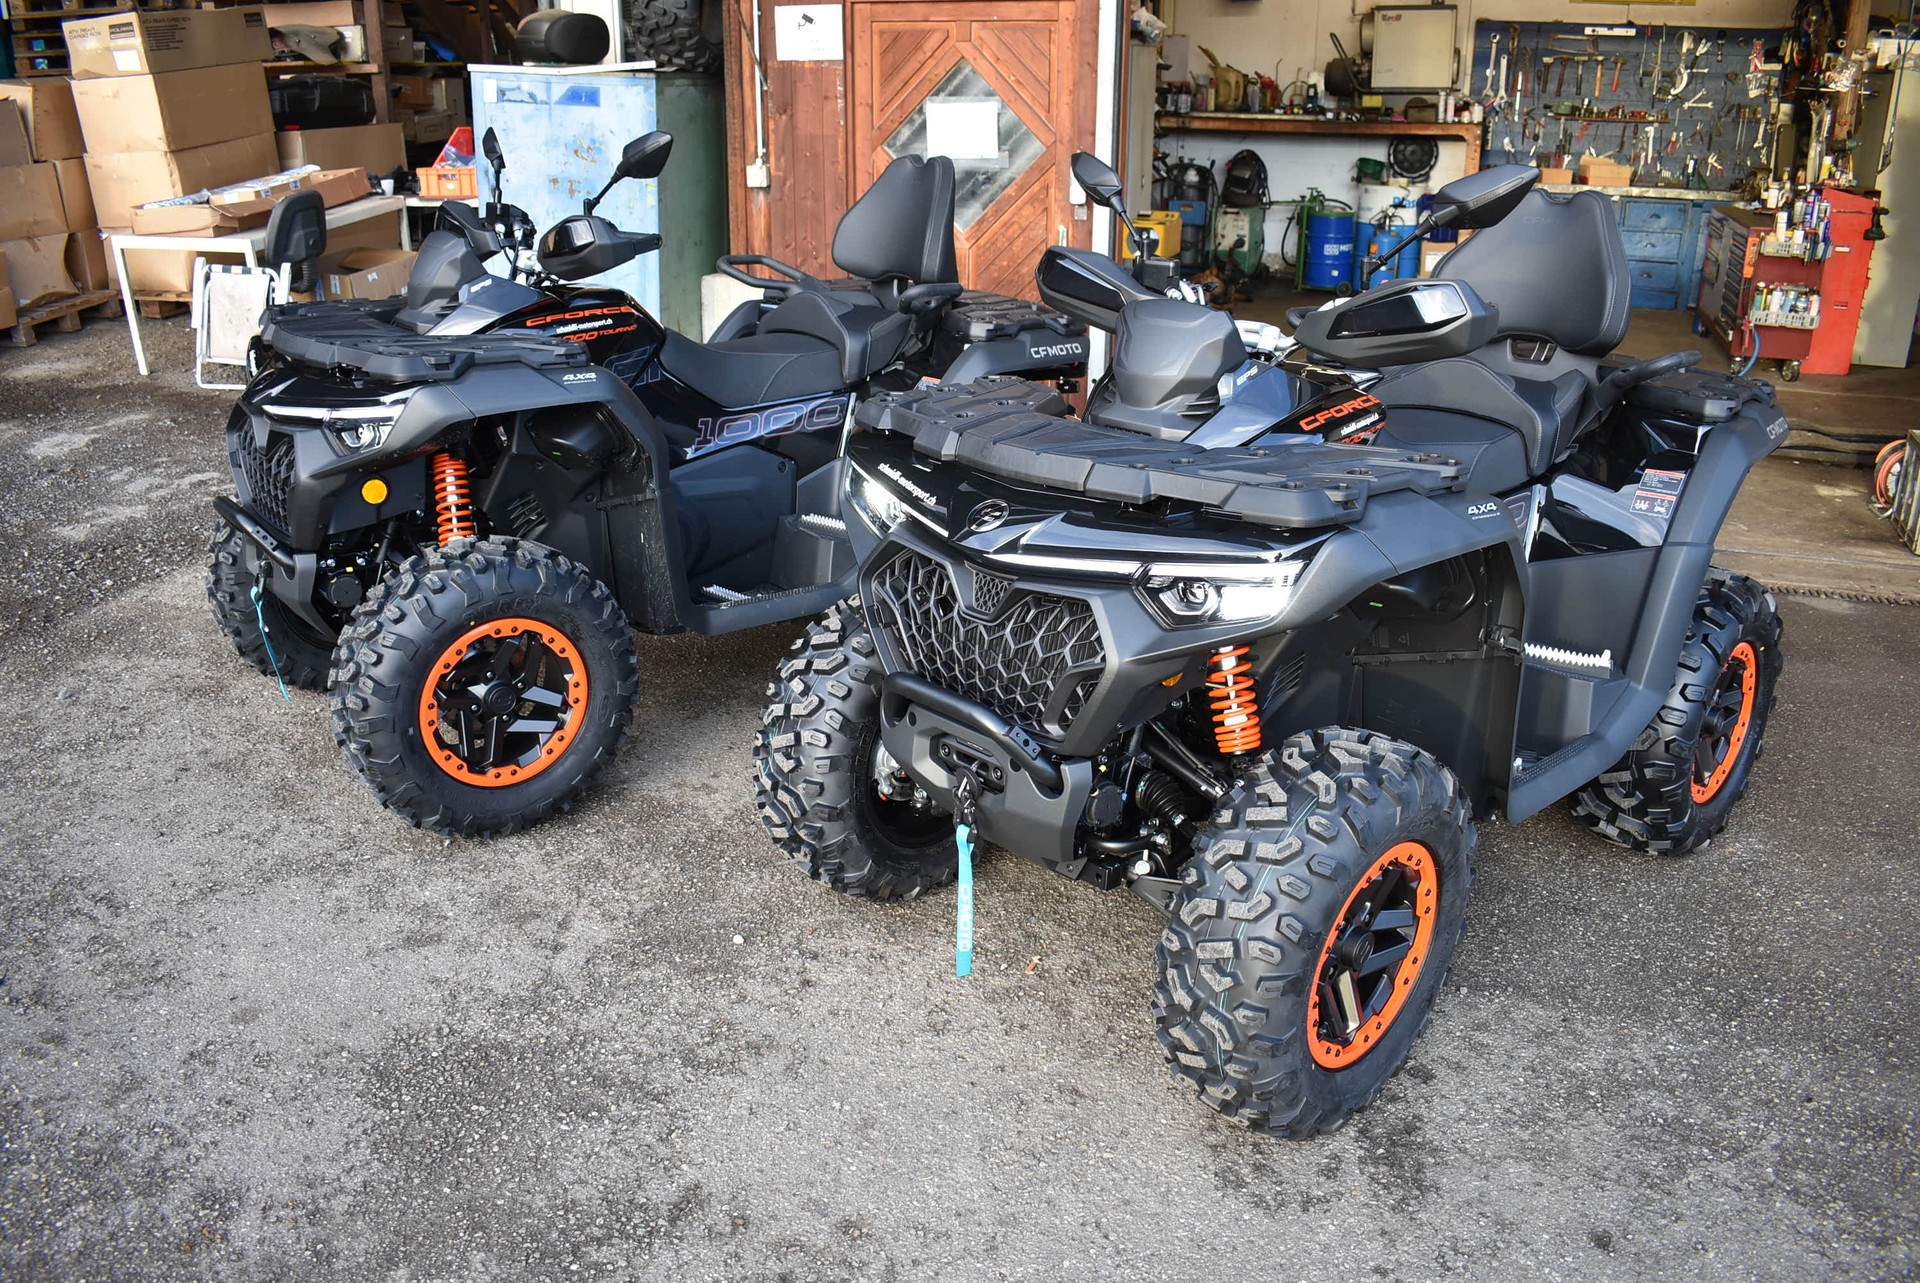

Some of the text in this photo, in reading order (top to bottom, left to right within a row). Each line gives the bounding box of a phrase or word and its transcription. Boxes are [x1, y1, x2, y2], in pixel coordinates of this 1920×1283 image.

[526, 305, 635, 327] CFORCE
[1031, 343, 1082, 358] CFMOTO
[1236, 365, 1259, 386] EPS
[695, 397, 848, 448] 1000
[1299, 394, 1381, 431] CFORCE
[1766, 417, 1788, 440] CFMOTO
[960, 884, 971, 952] CFMOTO
